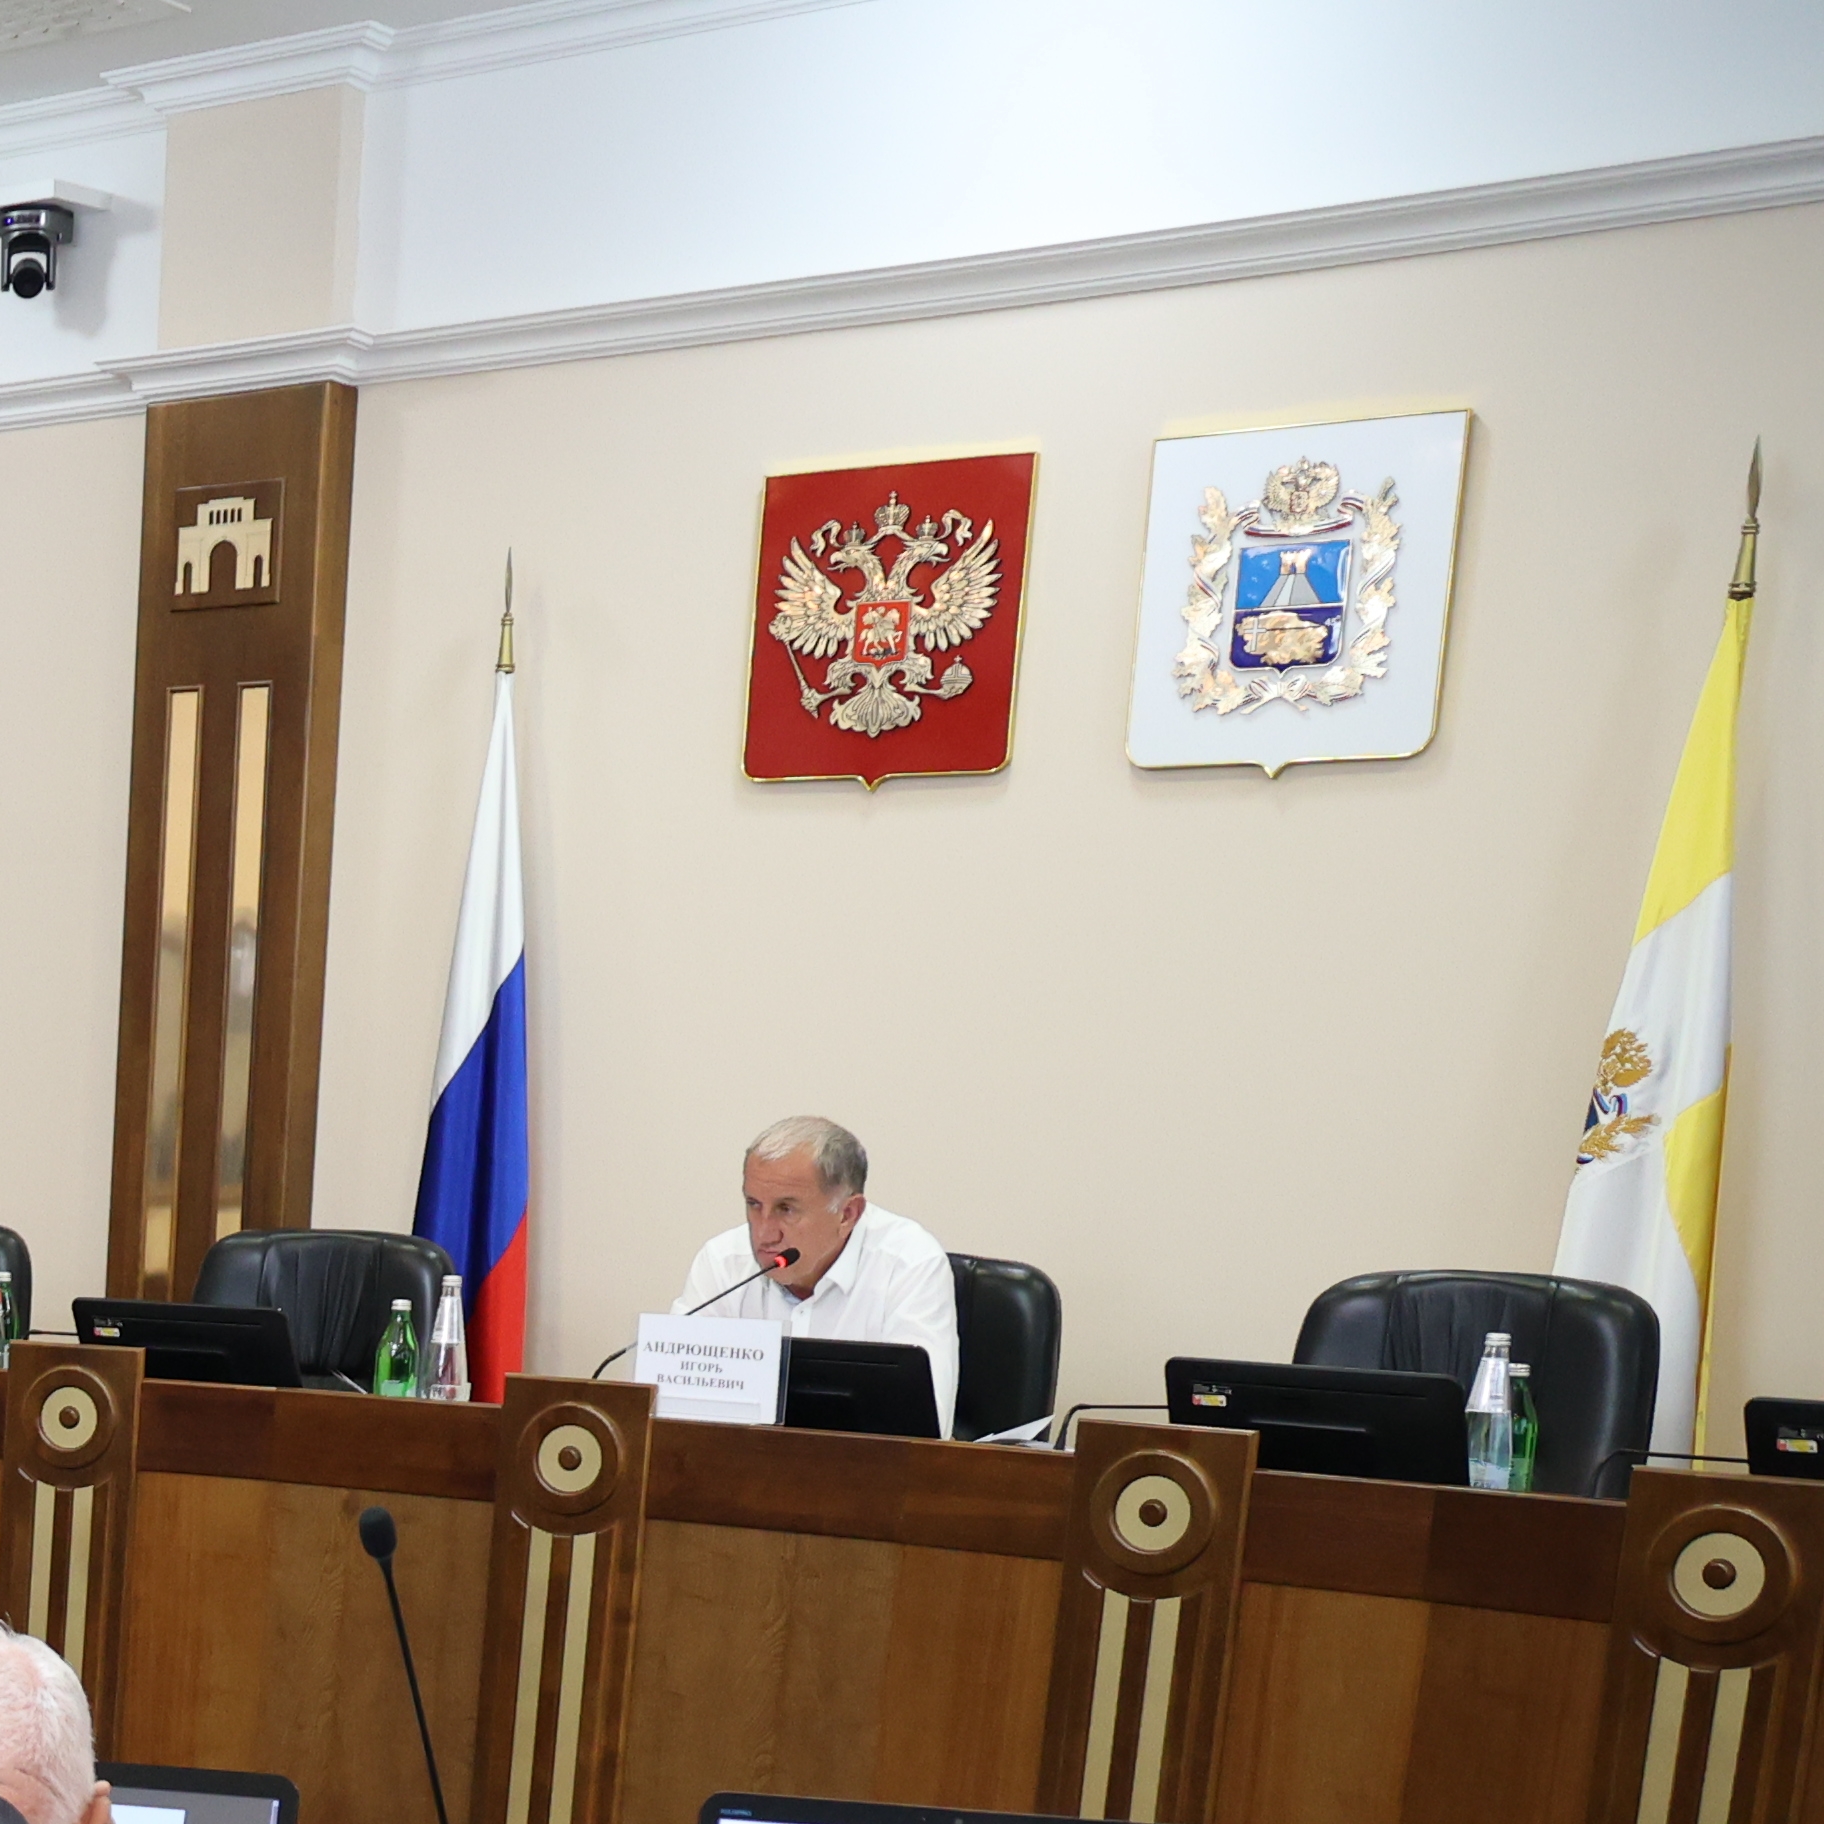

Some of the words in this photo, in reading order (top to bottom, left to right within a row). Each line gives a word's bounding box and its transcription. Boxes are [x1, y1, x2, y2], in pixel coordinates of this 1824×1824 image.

[643, 1340, 765, 1361] АНДРЮЩЕНКО
[680, 1360, 723, 1374] ИГОРЬ
[656, 1373, 745, 1390] ВАСИЛЬЕВИЧ
